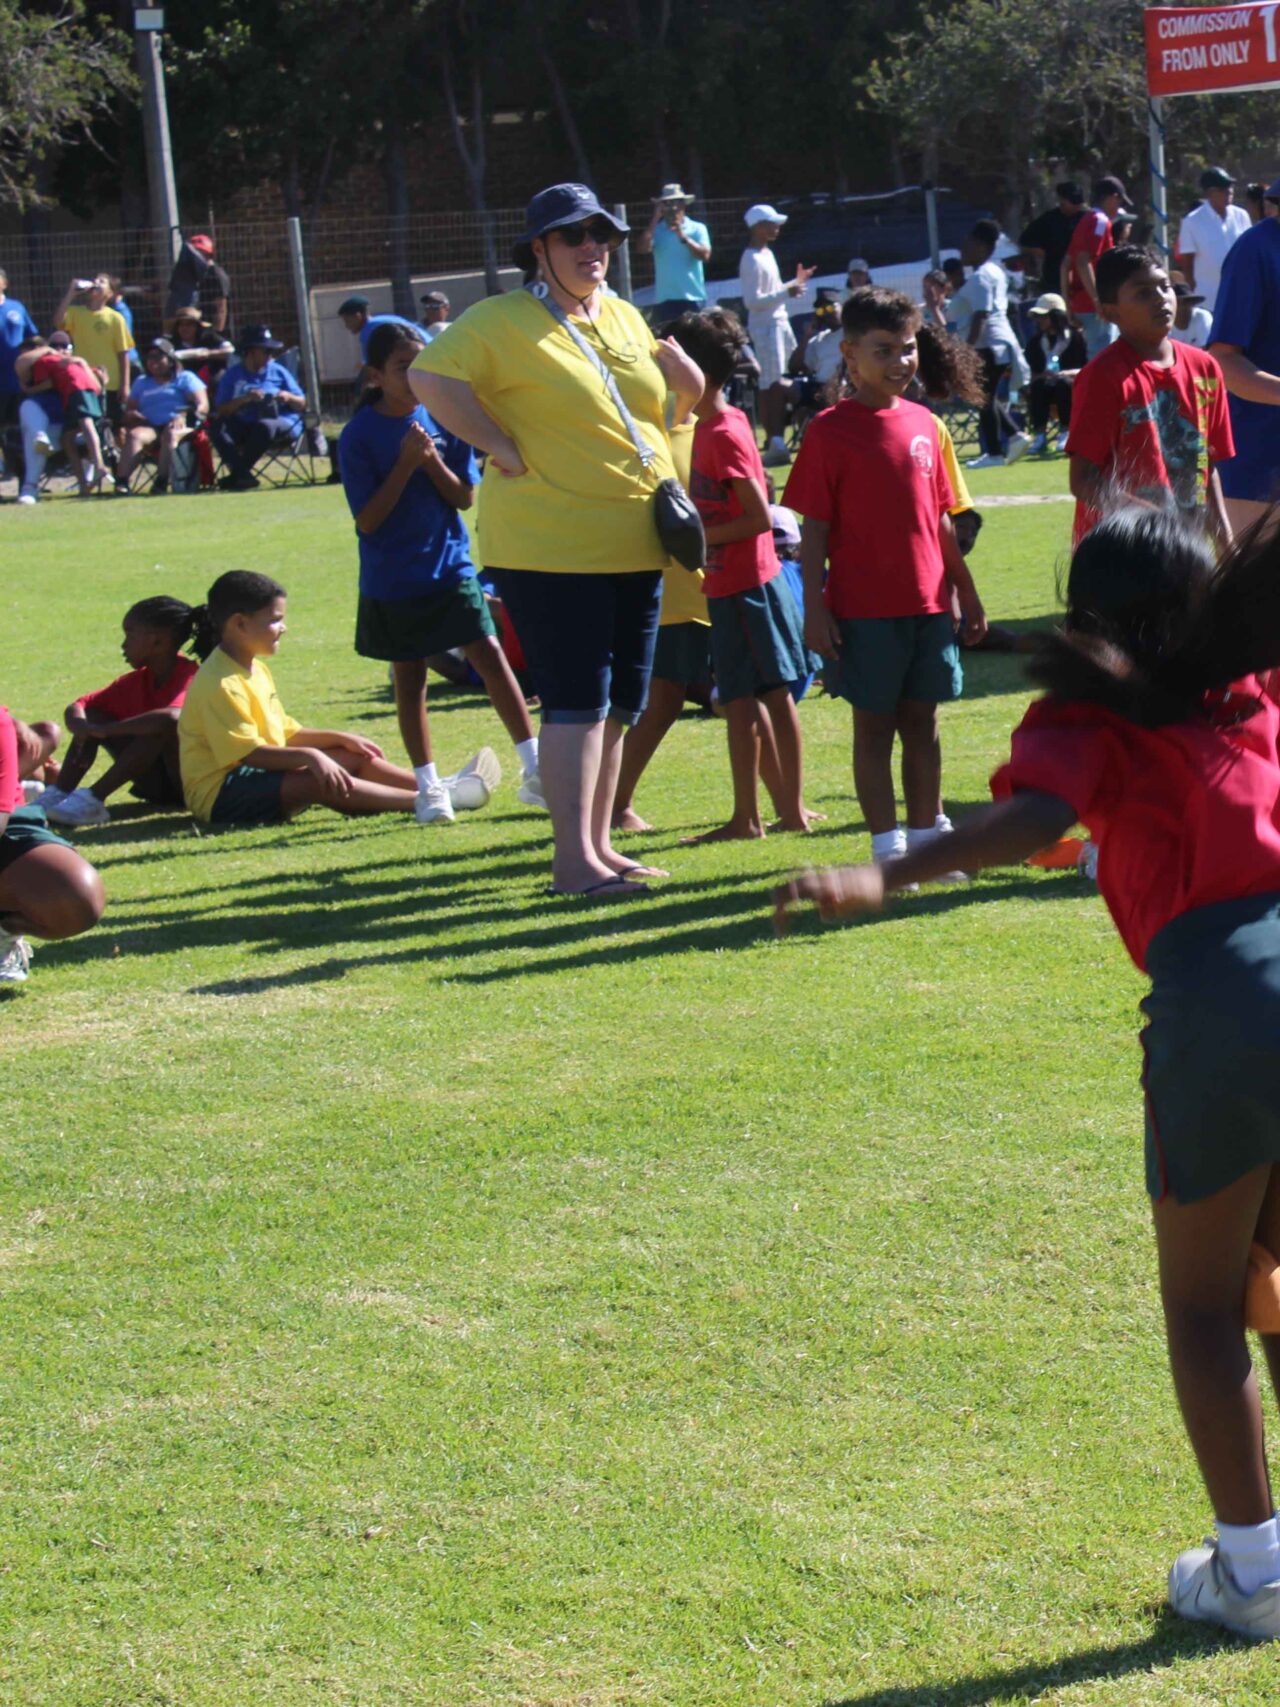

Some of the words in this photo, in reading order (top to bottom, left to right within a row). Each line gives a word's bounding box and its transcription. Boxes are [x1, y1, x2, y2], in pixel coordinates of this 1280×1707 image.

[1158, 9, 1253, 39] COMMISSION
[1161, 46, 1208, 73] FROM
[1210, 39, 1250, 67] ONLY
